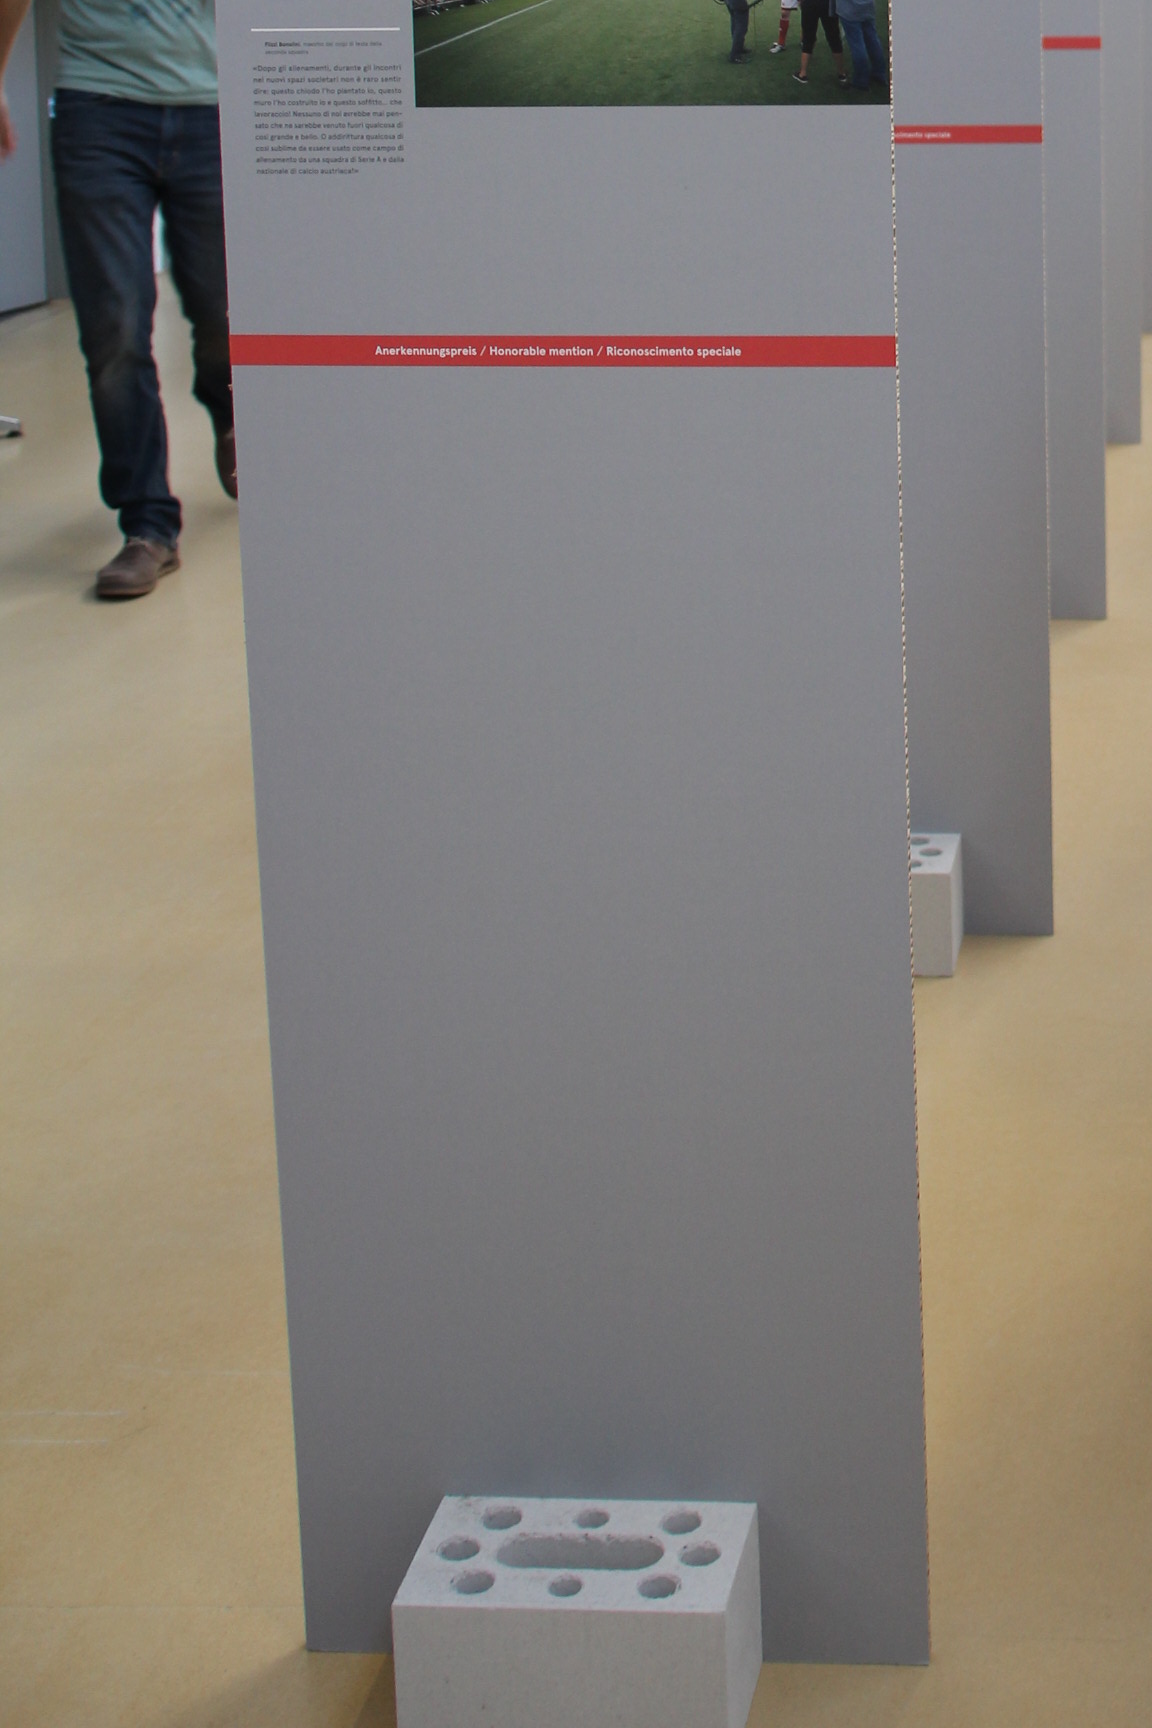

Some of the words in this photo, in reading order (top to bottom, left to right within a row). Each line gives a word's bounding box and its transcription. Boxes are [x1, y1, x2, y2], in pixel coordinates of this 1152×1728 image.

[375, 345, 477, 358] Anerkennungspreis
[489, 345, 546, 356] Honorable
[549, 346, 593, 357] mention
[606, 345, 694, 357] Riconoscimento
[697, 345, 742, 359] speciale
